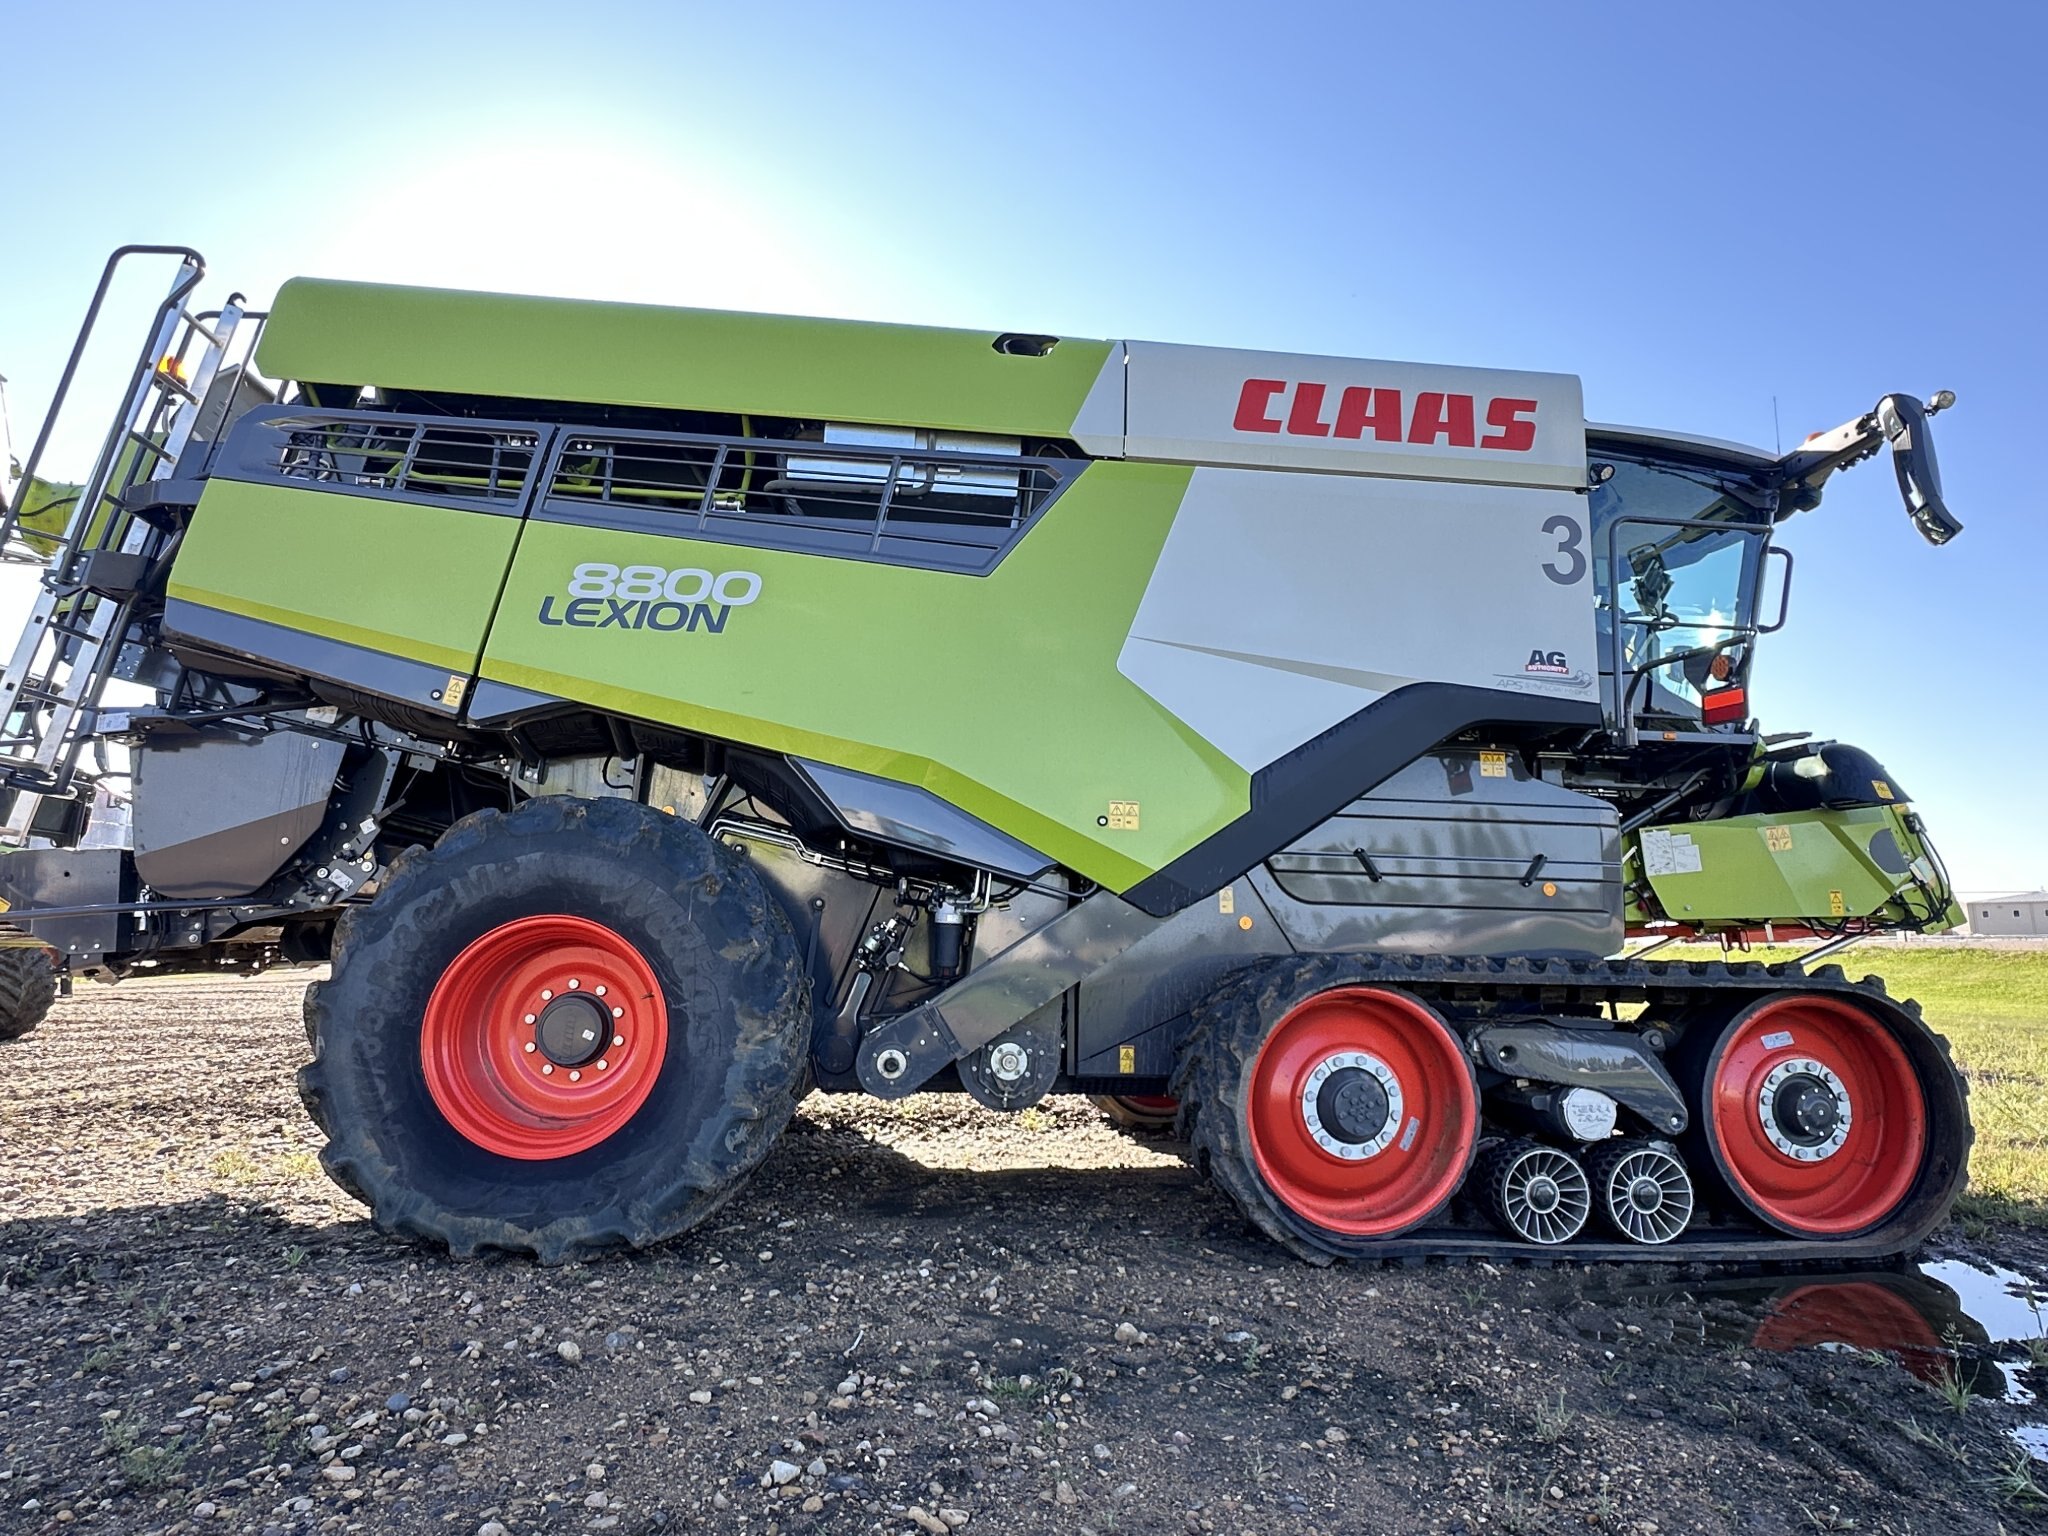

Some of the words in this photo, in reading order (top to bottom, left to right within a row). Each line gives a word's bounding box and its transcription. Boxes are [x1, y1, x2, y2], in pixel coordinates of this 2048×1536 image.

[1233, 379, 1537, 451] CLAAS
[1541, 515, 1587, 585] 3
[568, 562, 762, 606] 8800
[538, 596, 731, 634] LEXION
[1528, 649, 1567, 669] AG
